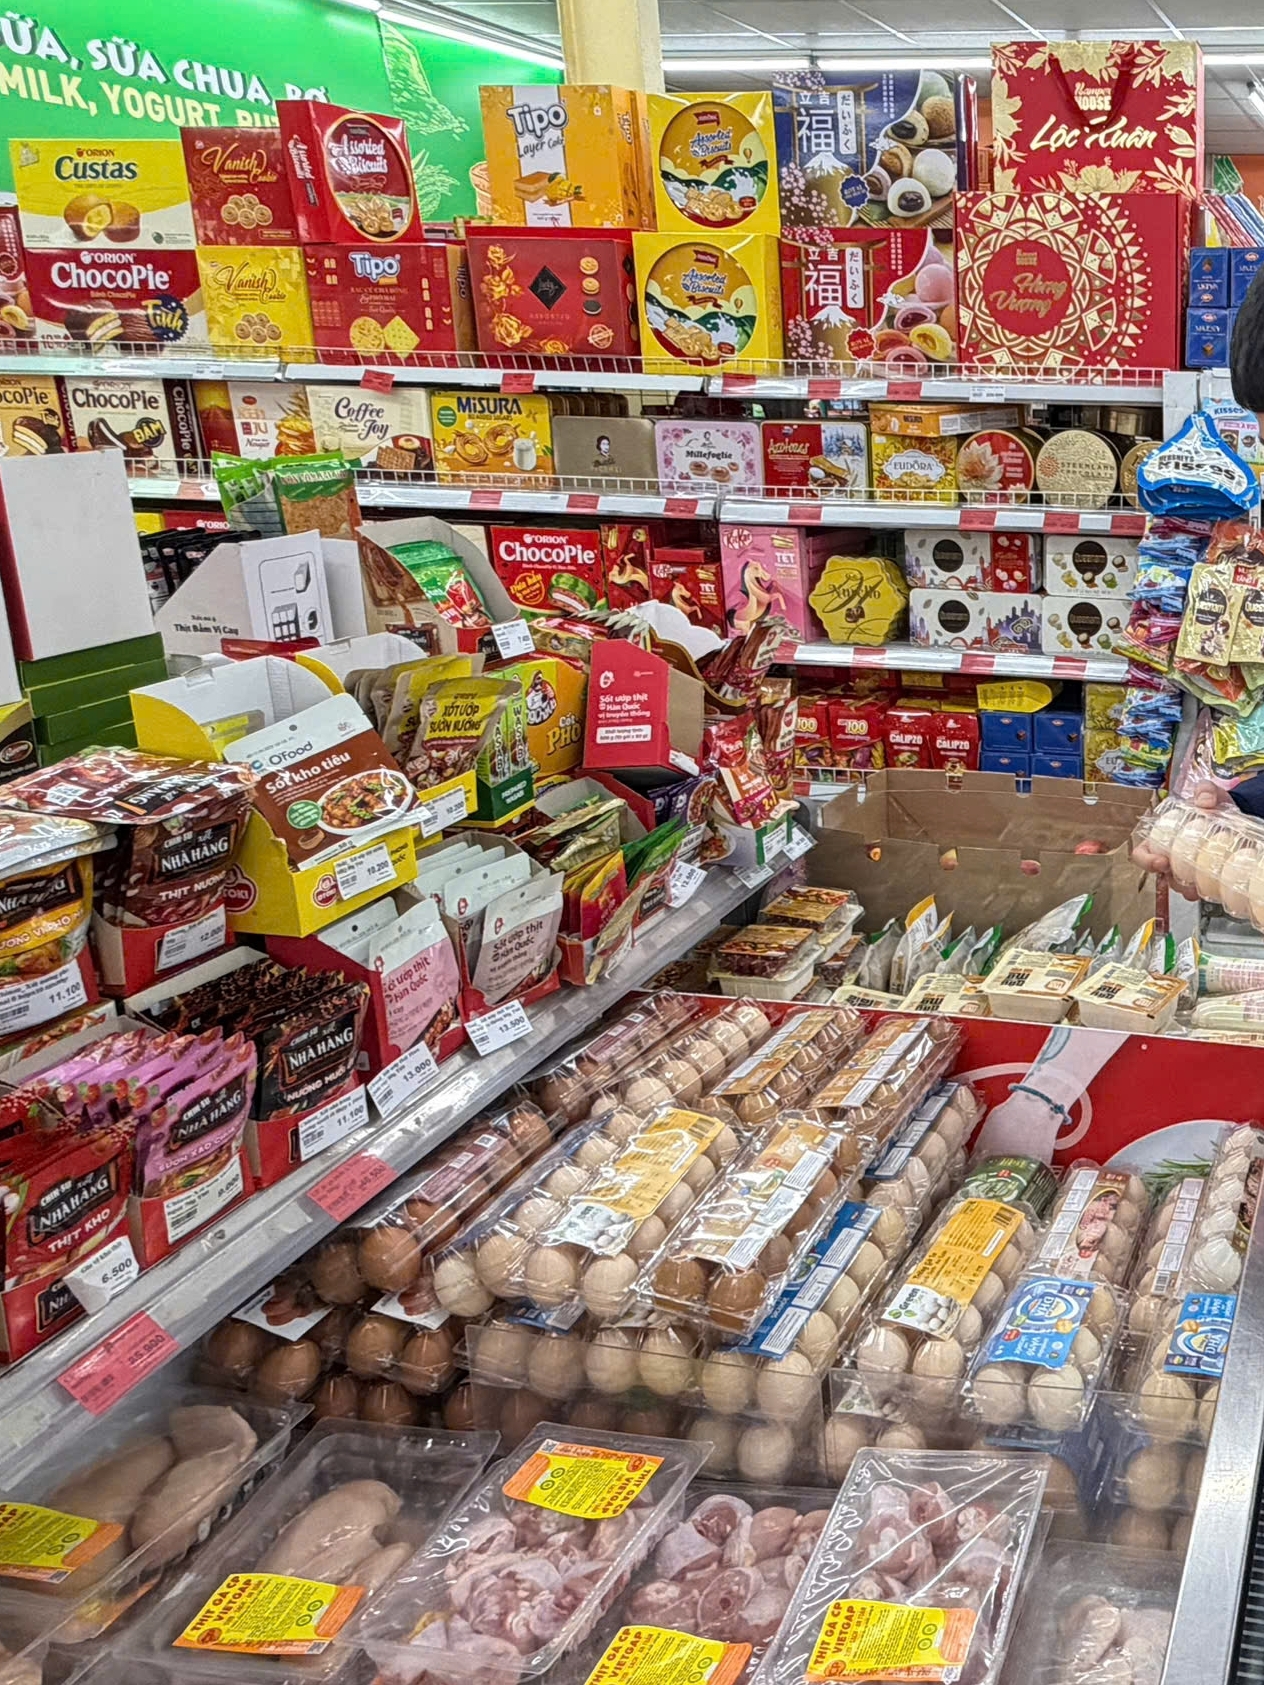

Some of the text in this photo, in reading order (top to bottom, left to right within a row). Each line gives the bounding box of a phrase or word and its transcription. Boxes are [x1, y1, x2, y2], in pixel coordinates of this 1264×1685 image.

[0, 11, 82, 70] ỮA,
[86, 36, 170, 85] SỮA
[0, 62, 98, 117] MILK,
[506, 103, 569, 138] Tipo
[797, 109, 836, 153] 福
[1029, 115, 1081, 153] Lộc
[201, 144, 267, 175] Vanish
[327, 134, 386, 158] Assorted
[54, 156, 138, 182] Custas
[94, 252, 136, 264] ORION
[350, 252, 400, 283] Tipo
[51, 262, 170, 290] ChocoPie
[214, 264, 276, 294] Vanish
[805, 264, 842, 306] 福
[72, 388, 161, 410] ChocoPie
[335, 396, 385, 424] Coffee
[172, 386, 191, 450] ChocoPie
[357, 418, 391, 441] Joy
[685, 449, 733, 461] Millefoglie
[204, 520, 231, 530] ORIO
[499, 541, 597, 564] ChocoPie
[534, 535, 569, 545] ORION
[293, 765, 321, 784] kho
[321, 751, 351, 770] tiêu
[160, 837, 229, 873] NHÀ HÀNG
[158, 886, 190, 901] THỊT
[221, 887, 250, 900] TOKI
[49, 981, 82, 1004] 11.100
[289, 1027, 353, 1070] NHÀ HÀNG
[402, 1058, 432, 1083] 13.000
[208, 1090, 242, 1123] HÀNG
[39, 1173, 111, 1229] NHÀ HÀNG
[40, 1179, 73, 1208] CHIN-SU
[48, 1208, 112, 1254] THỊT KHO
[101, 1258, 133, 1285] 6.500
[898, 1287, 921, 1311] Green
[212, 1578, 253, 1623] VIETGAP
[830, 1601, 843, 1618] CP
[617, 1626, 632, 1643] CP
[832, 1604, 857, 1654] VIETGAP
[608, 1630, 643, 1679] VIETGAP
